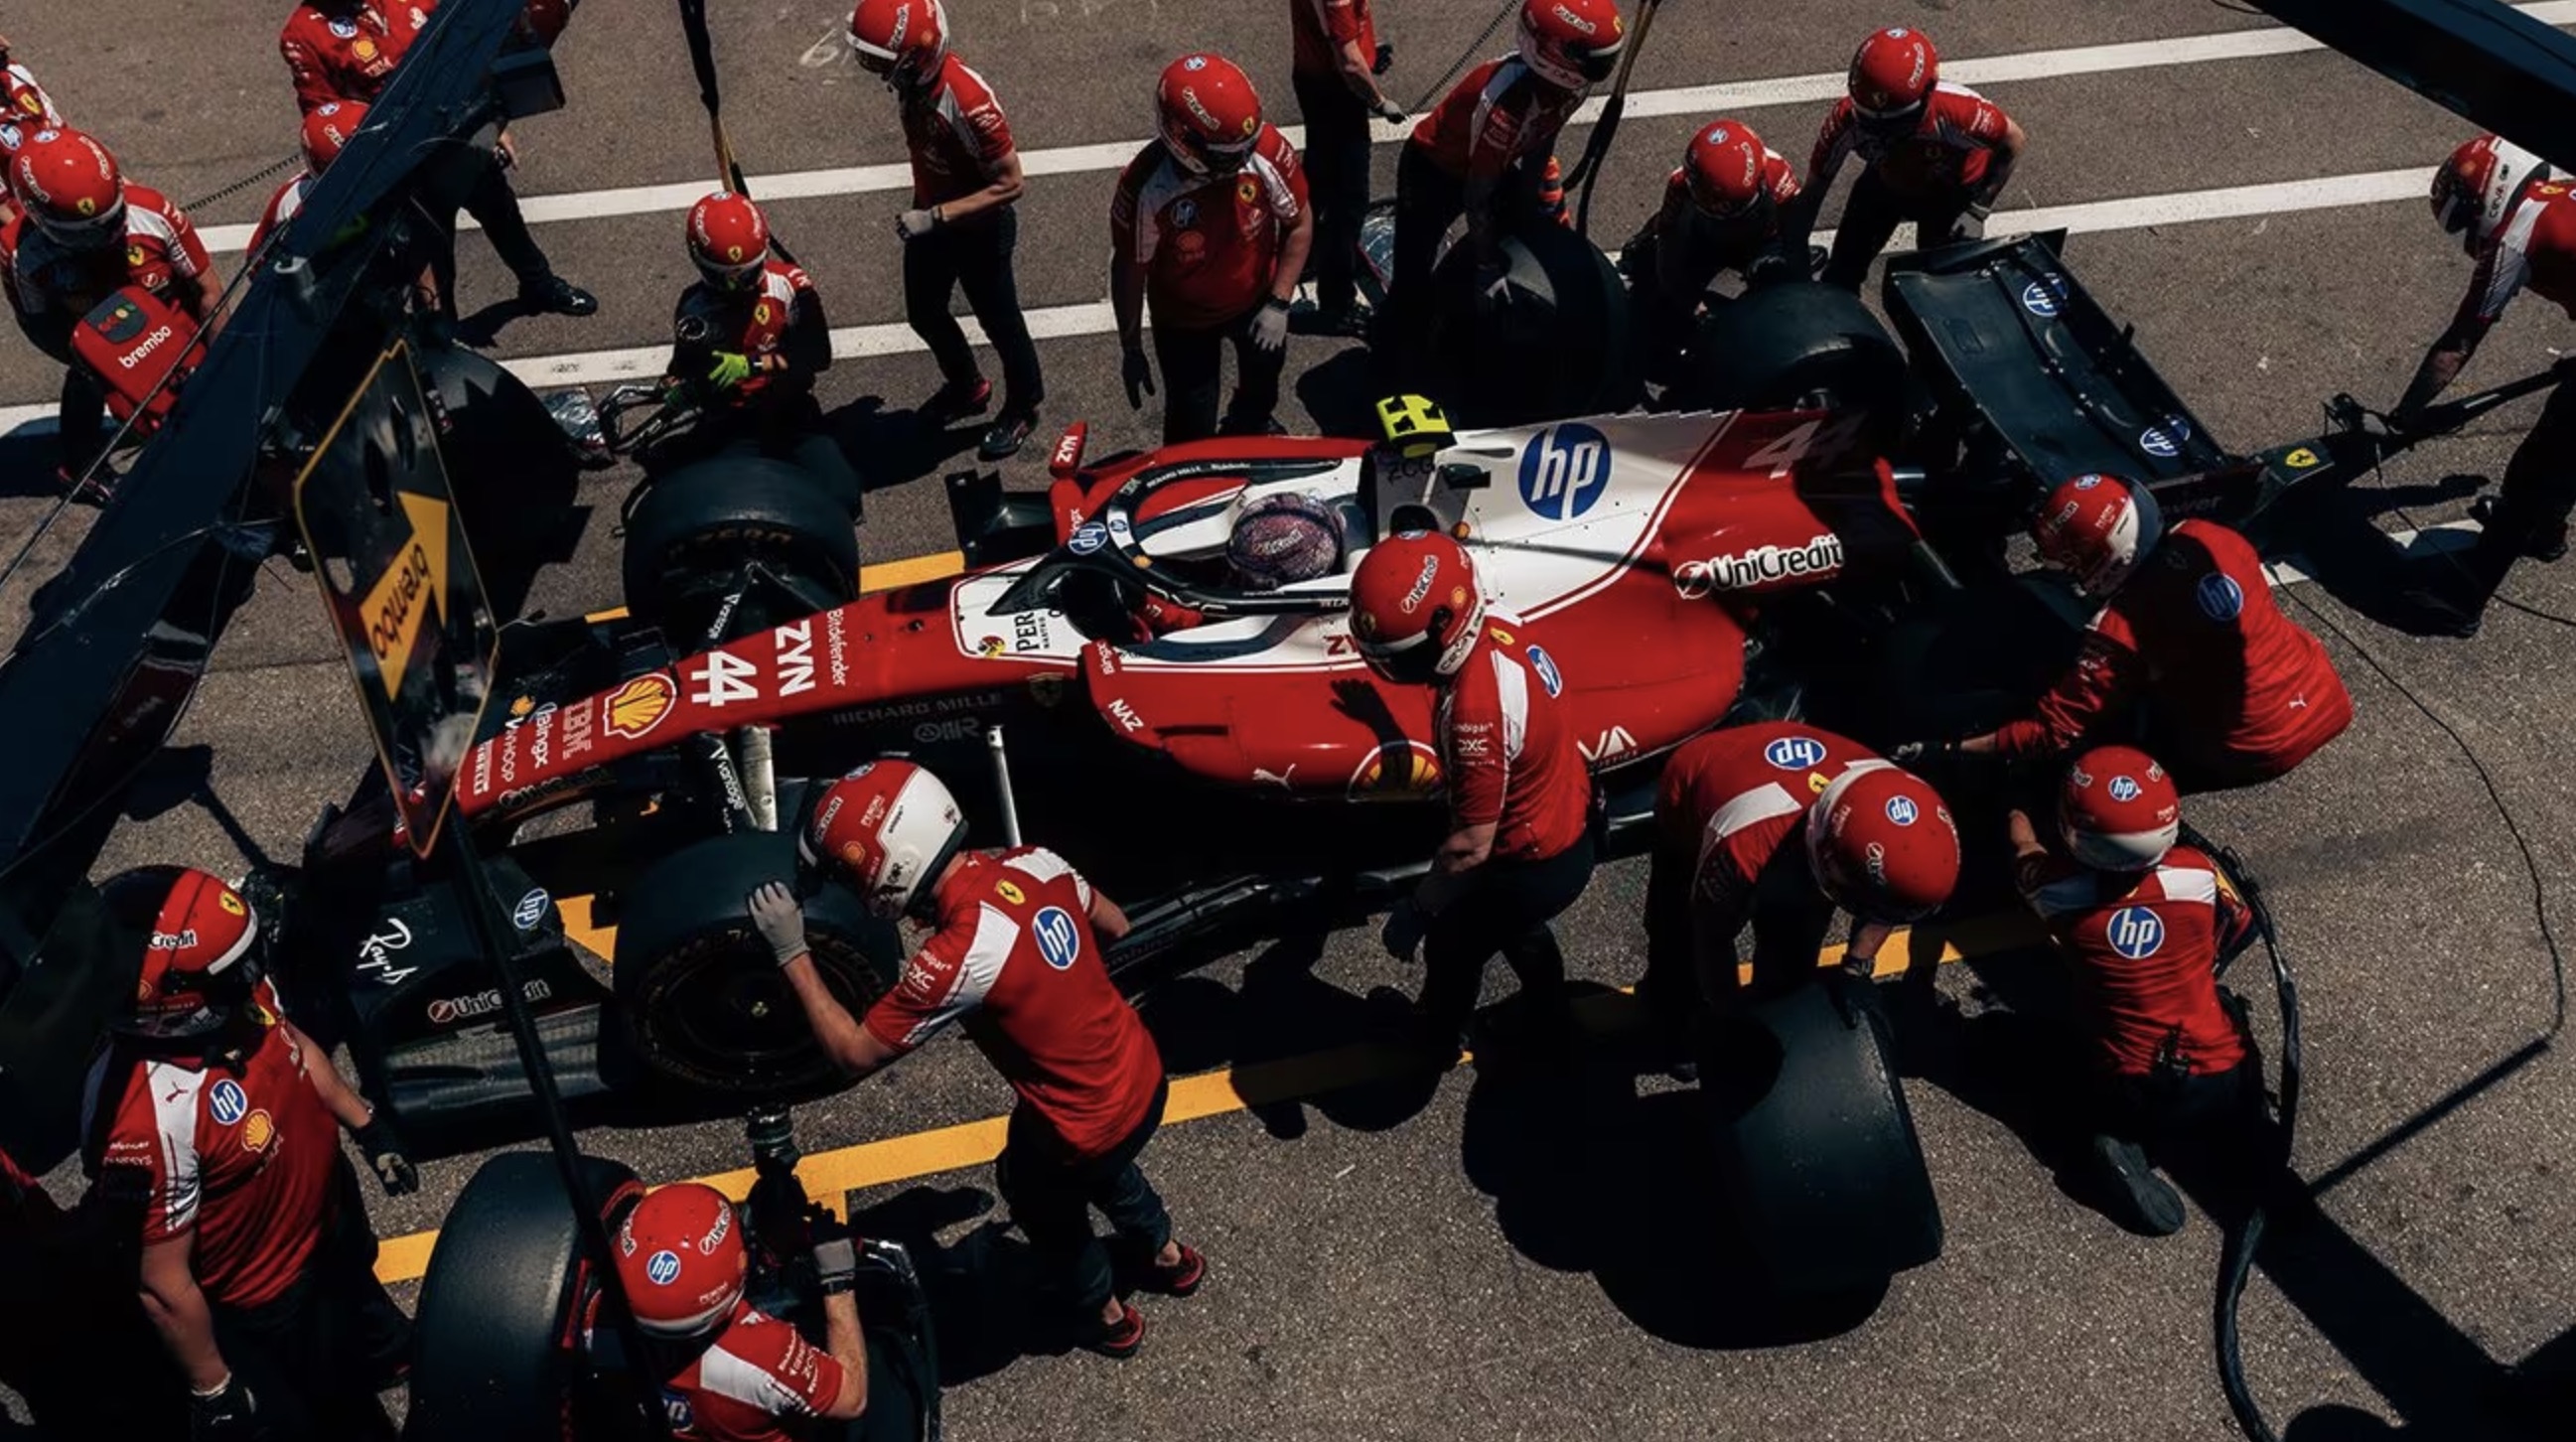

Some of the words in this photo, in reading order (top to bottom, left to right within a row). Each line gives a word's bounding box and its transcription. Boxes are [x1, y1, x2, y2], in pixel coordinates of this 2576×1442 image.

[117, 325, 172, 370] brembo
[1520, 422, 1611, 520] hp
[1069, 520, 1108, 555] hp
[1711, 533, 1845, 591] UniCredit
[826, 608, 850, 687] Bitdefender
[1013, 612, 1041, 651] PER
[690, 649, 760, 707] 44
[774, 618, 816, 697] ZYN
[562, 696, 594, 761] IBM
[1108, 698, 1145, 733] ZYN
[1577, 725, 1639, 762] VA
[1765, 737, 1827, 771] hp
[2108, 775, 2138, 802] hp
[1886, 795, 1918, 826] hp
[513, 888, 549, 930] hp
[149, 929, 198, 951] Credit
[1032, 906, 1079, 971] hp
[2106, 906, 2165, 959] hp
[210, 1079, 247, 1125] hp
[646, 1249, 681, 1286] hp
